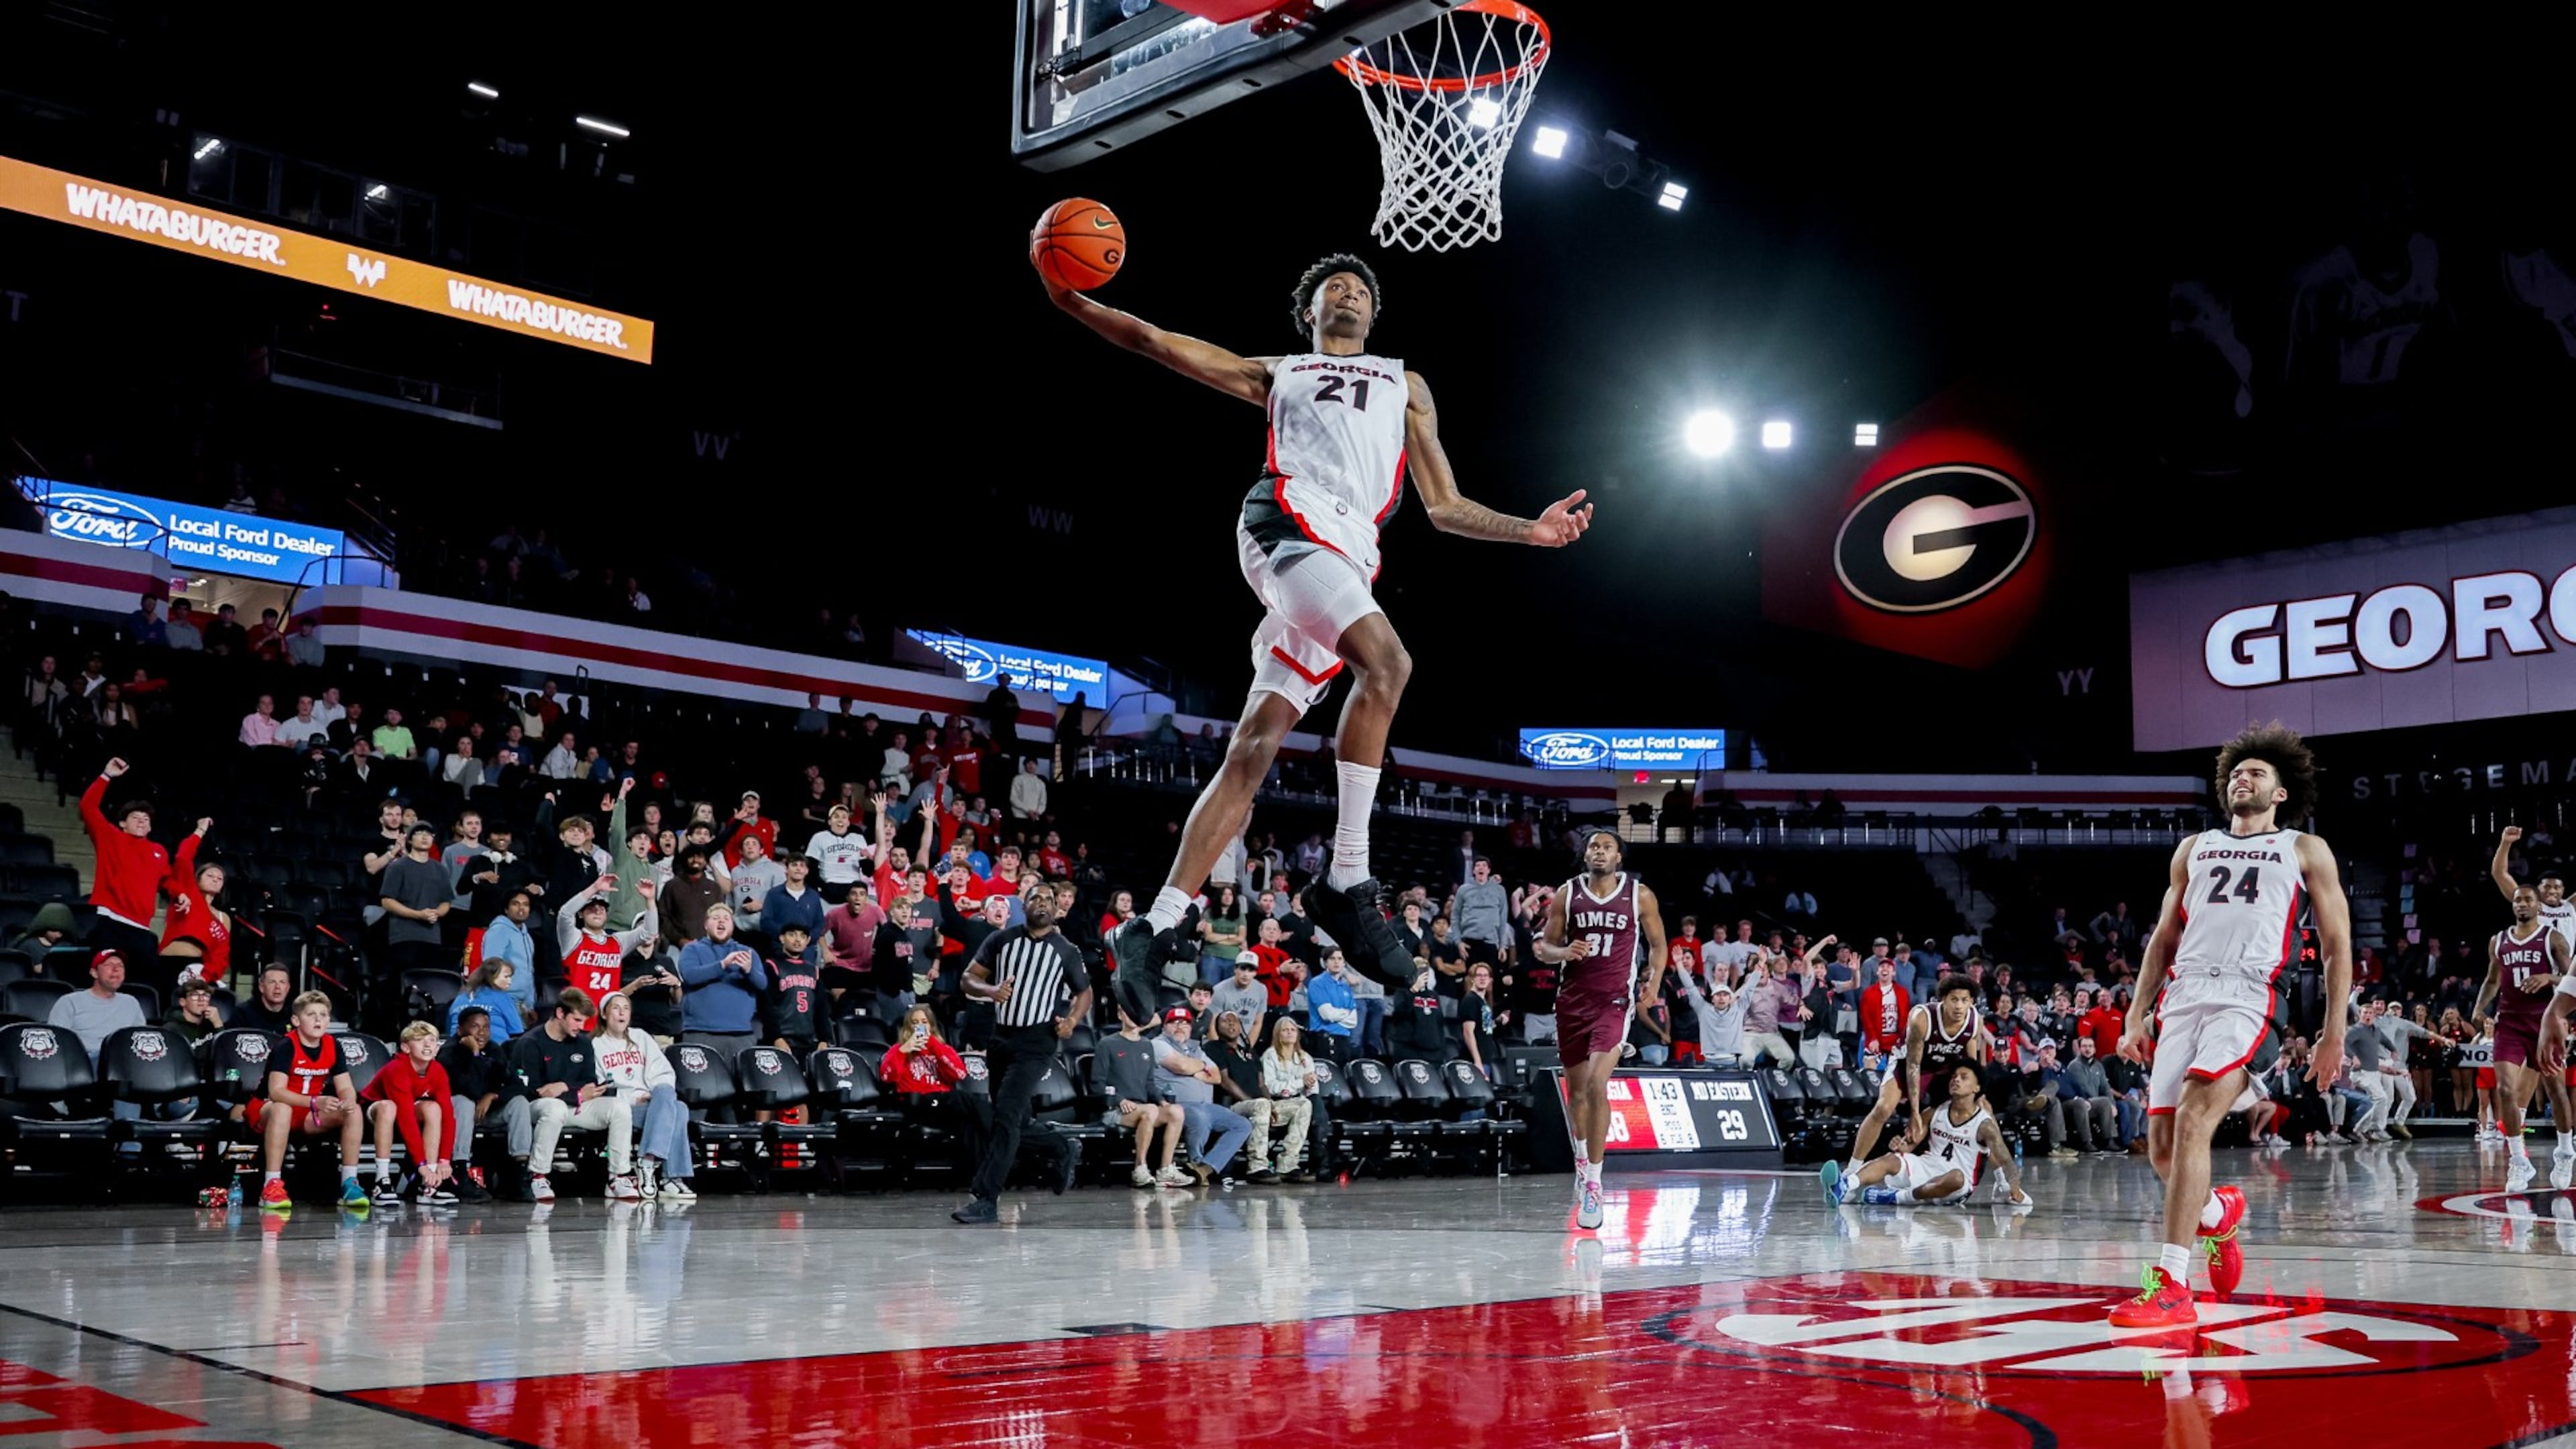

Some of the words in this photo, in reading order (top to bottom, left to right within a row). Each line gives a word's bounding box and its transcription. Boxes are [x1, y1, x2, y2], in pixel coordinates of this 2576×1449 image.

[1291, 362, 1396, 384] GEORGIA
[1313, 374, 1370, 412] 21
[50, 497, 139, 541] Ford
[168, 514, 220, 539] Local
[225, 523, 268, 547] Ford
[274, 529, 335, 558] Dealer
[168, 537, 215, 556] Proud
[217, 543, 280, 566] Sponsor
[1000, 653, 1032, 672] Local
[1063, 664, 1102, 684] Dealer
[1541, 737, 1595, 760] Ford
[1611, 737, 1644, 749] Local
[1647, 737, 1675, 749] Ford
[1678, 737, 1719, 750] Dealer
[1643, 751, 1683, 763] Sponsor
[2197, 850, 2283, 864] GEORGIA
[2206, 865, 2261, 904] 24
[1574, 911, 1629, 930] UMES
[1585, 932, 1614, 957] 31
[2502, 950, 2542, 966] UMES
[589, 972, 611, 991] 24
[2512, 966, 2531, 988] 11
[796, 990, 809, 1014] 5
[2461, 1050, 2494, 1063] NO
[301, 1075, 313, 1094] 1
[1649, 1081, 1678, 1100] 1:43
[1717, 1109, 1748, 1140] 29
[1931, 1128, 1970, 1147] GEORGIA
[1941, 1142, 1954, 1163] 4
